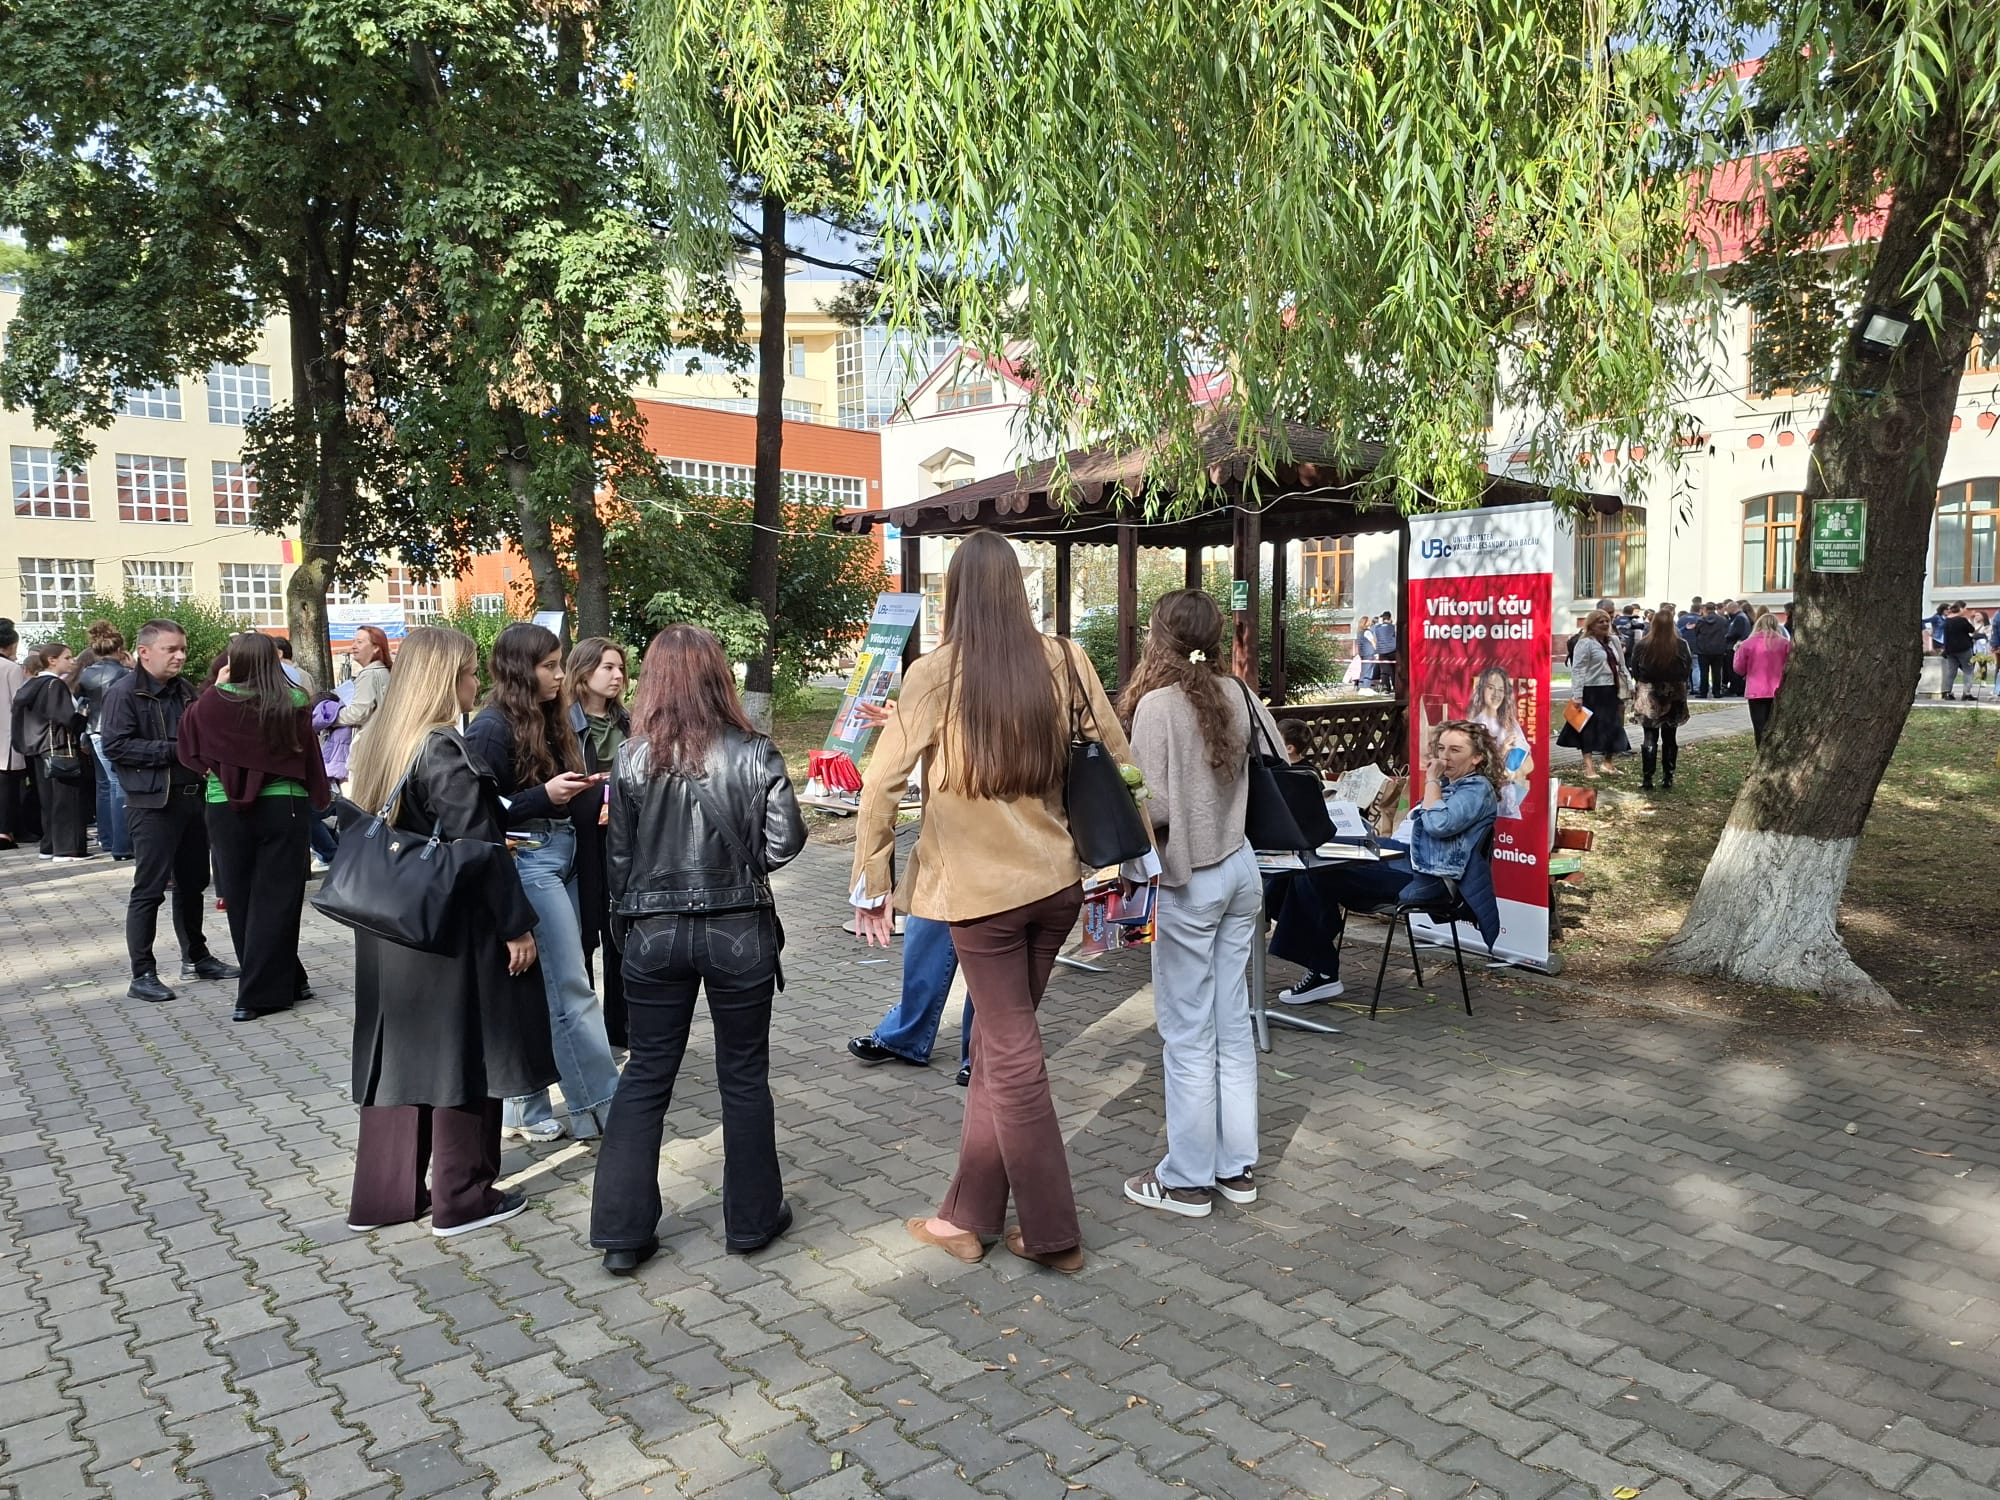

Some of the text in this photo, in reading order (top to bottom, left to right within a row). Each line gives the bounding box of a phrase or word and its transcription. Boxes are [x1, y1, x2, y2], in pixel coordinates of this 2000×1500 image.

[1422, 538, 1452, 559] UBc
[1426, 594, 1531, 616] Viitorul tău
[1423, 618, 1534, 643] începe aici!
[1517, 678, 1527, 696] LA
[1527, 678, 1538, 745] STUDENT
[1498, 832, 1514, 844] de
[1493, 847, 1537, 866] omice
